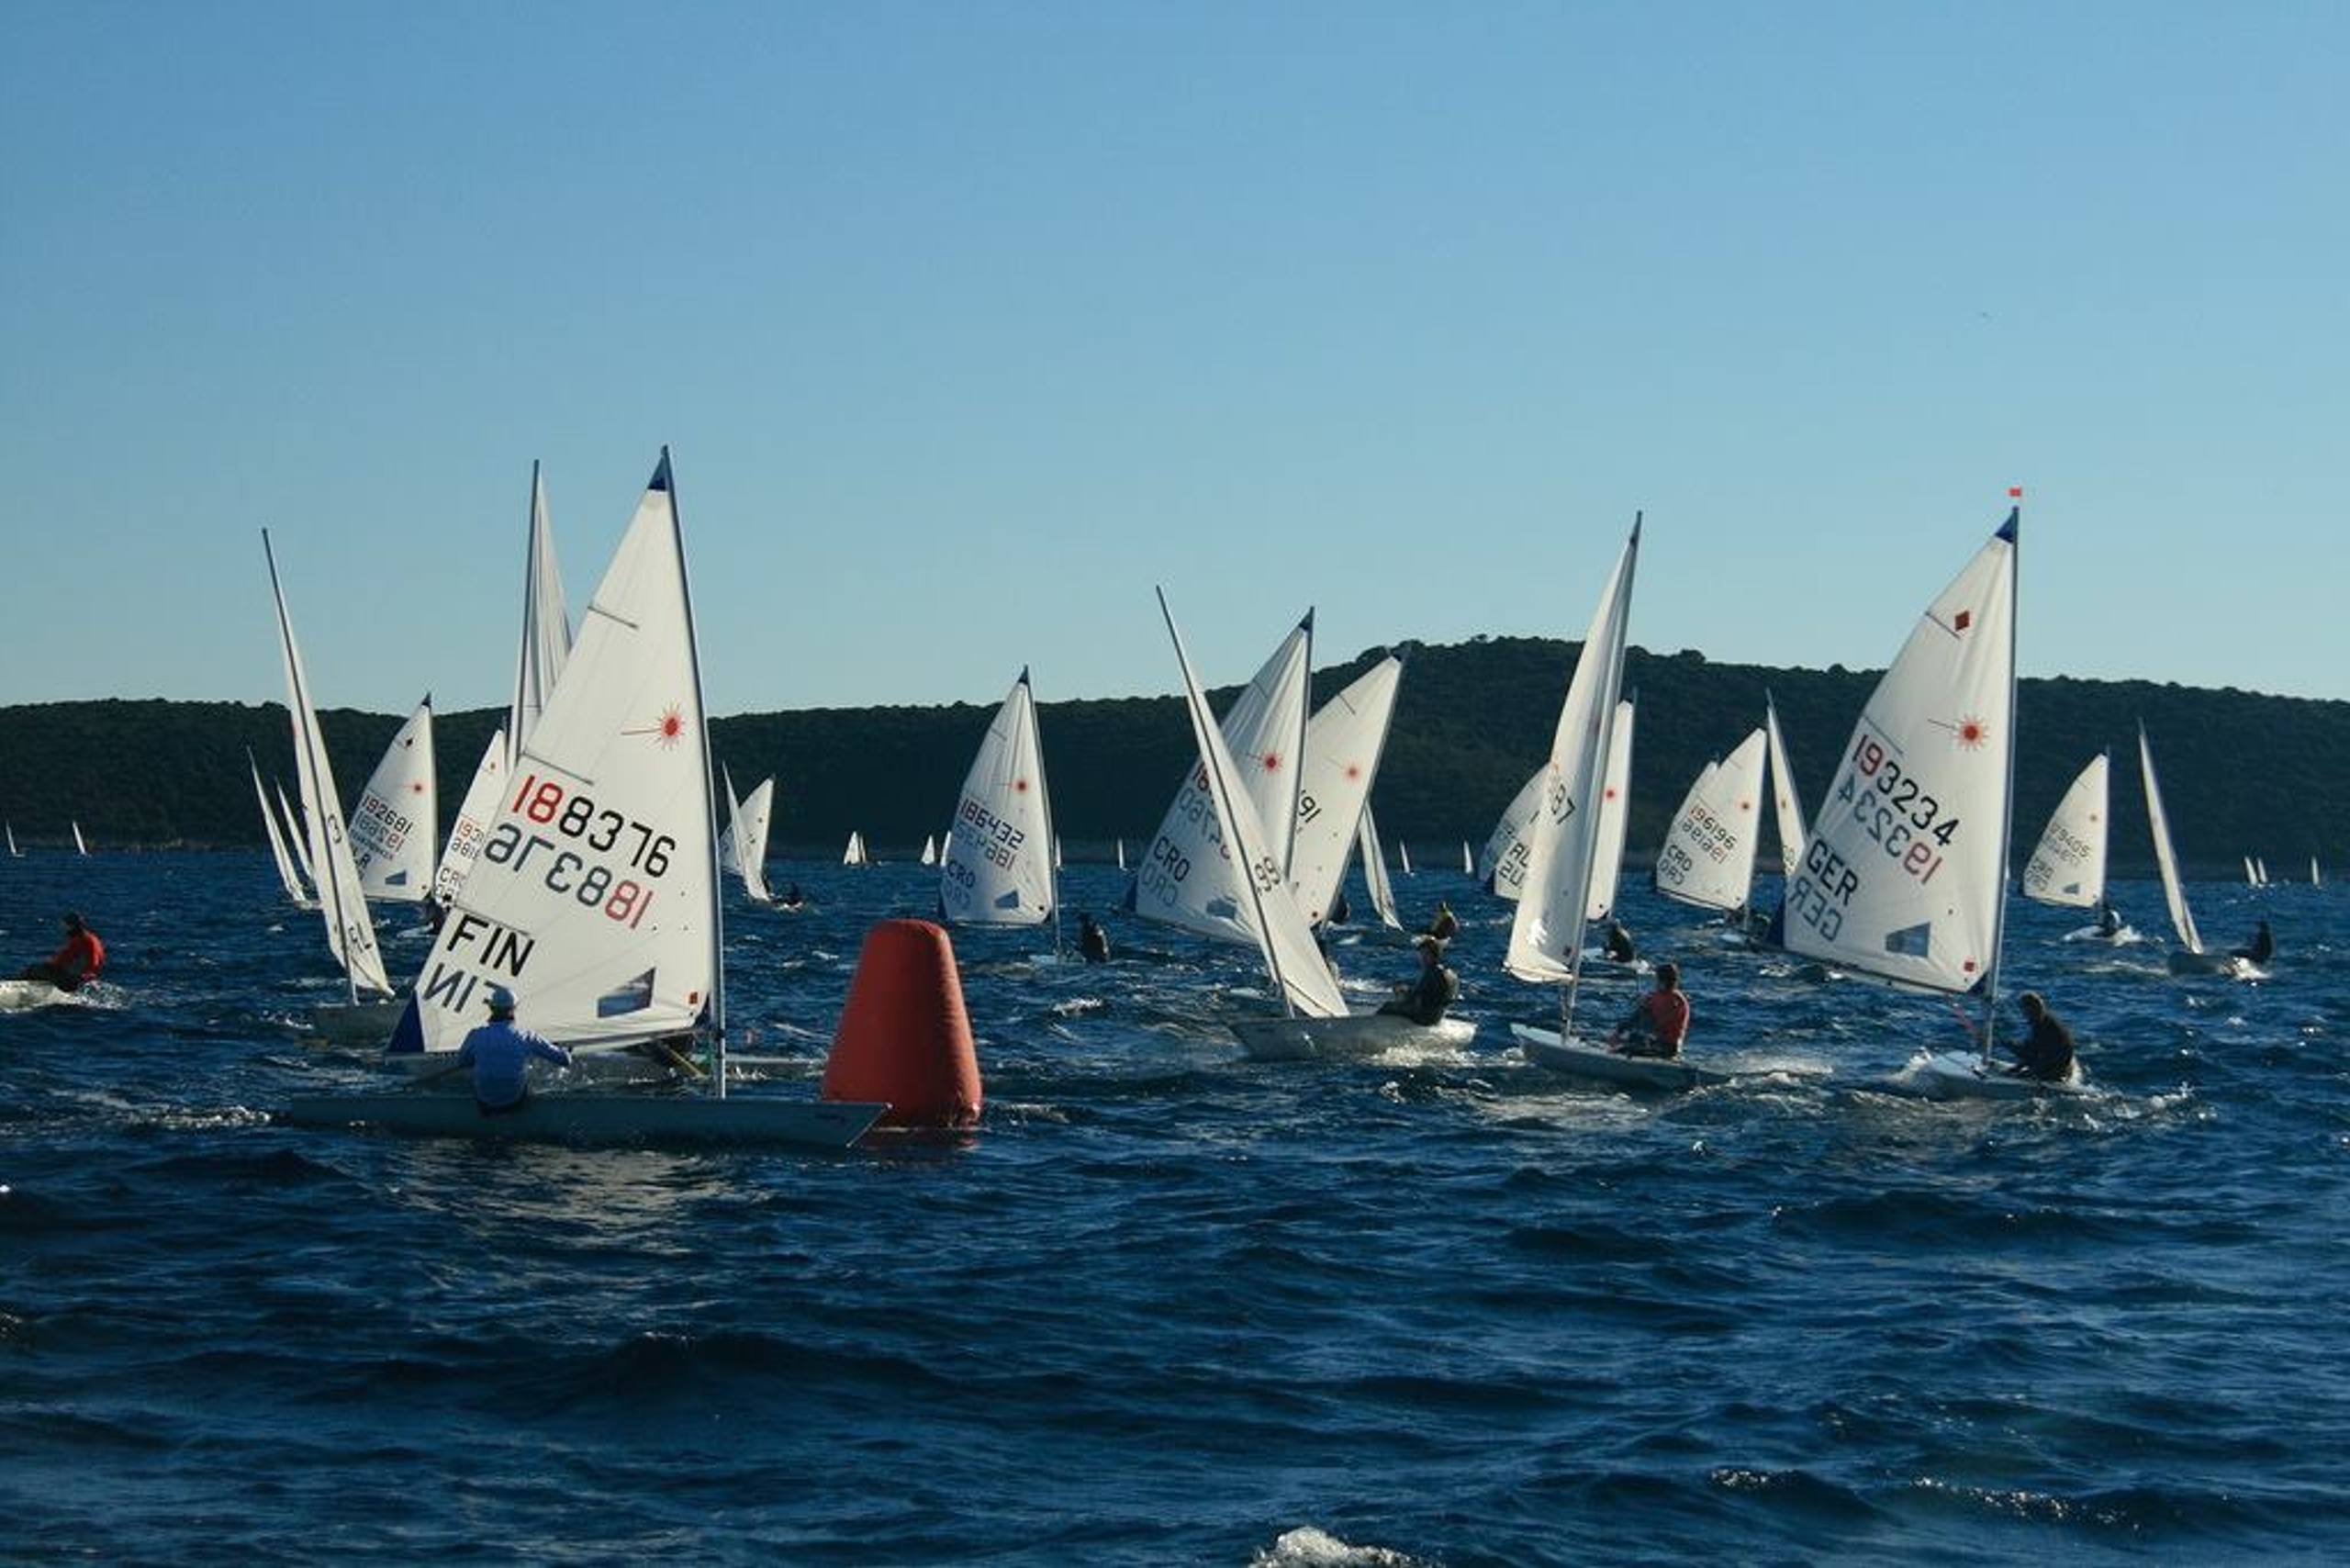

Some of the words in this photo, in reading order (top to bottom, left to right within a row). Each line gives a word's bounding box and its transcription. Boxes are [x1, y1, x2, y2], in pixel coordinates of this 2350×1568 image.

[362, 794, 414, 835] 192681
[1852, 734, 1959, 846] 193234
[512, 775, 677, 878] 188376
[960, 798, 1024, 851] 186432
[946, 859, 976, 889] CRO
[1153, 835, 1192, 883] CRO
[1666, 844, 1693, 872] CRO
[1806, 839, 1860, 907] GER
[446, 913, 535, 978] FIN
